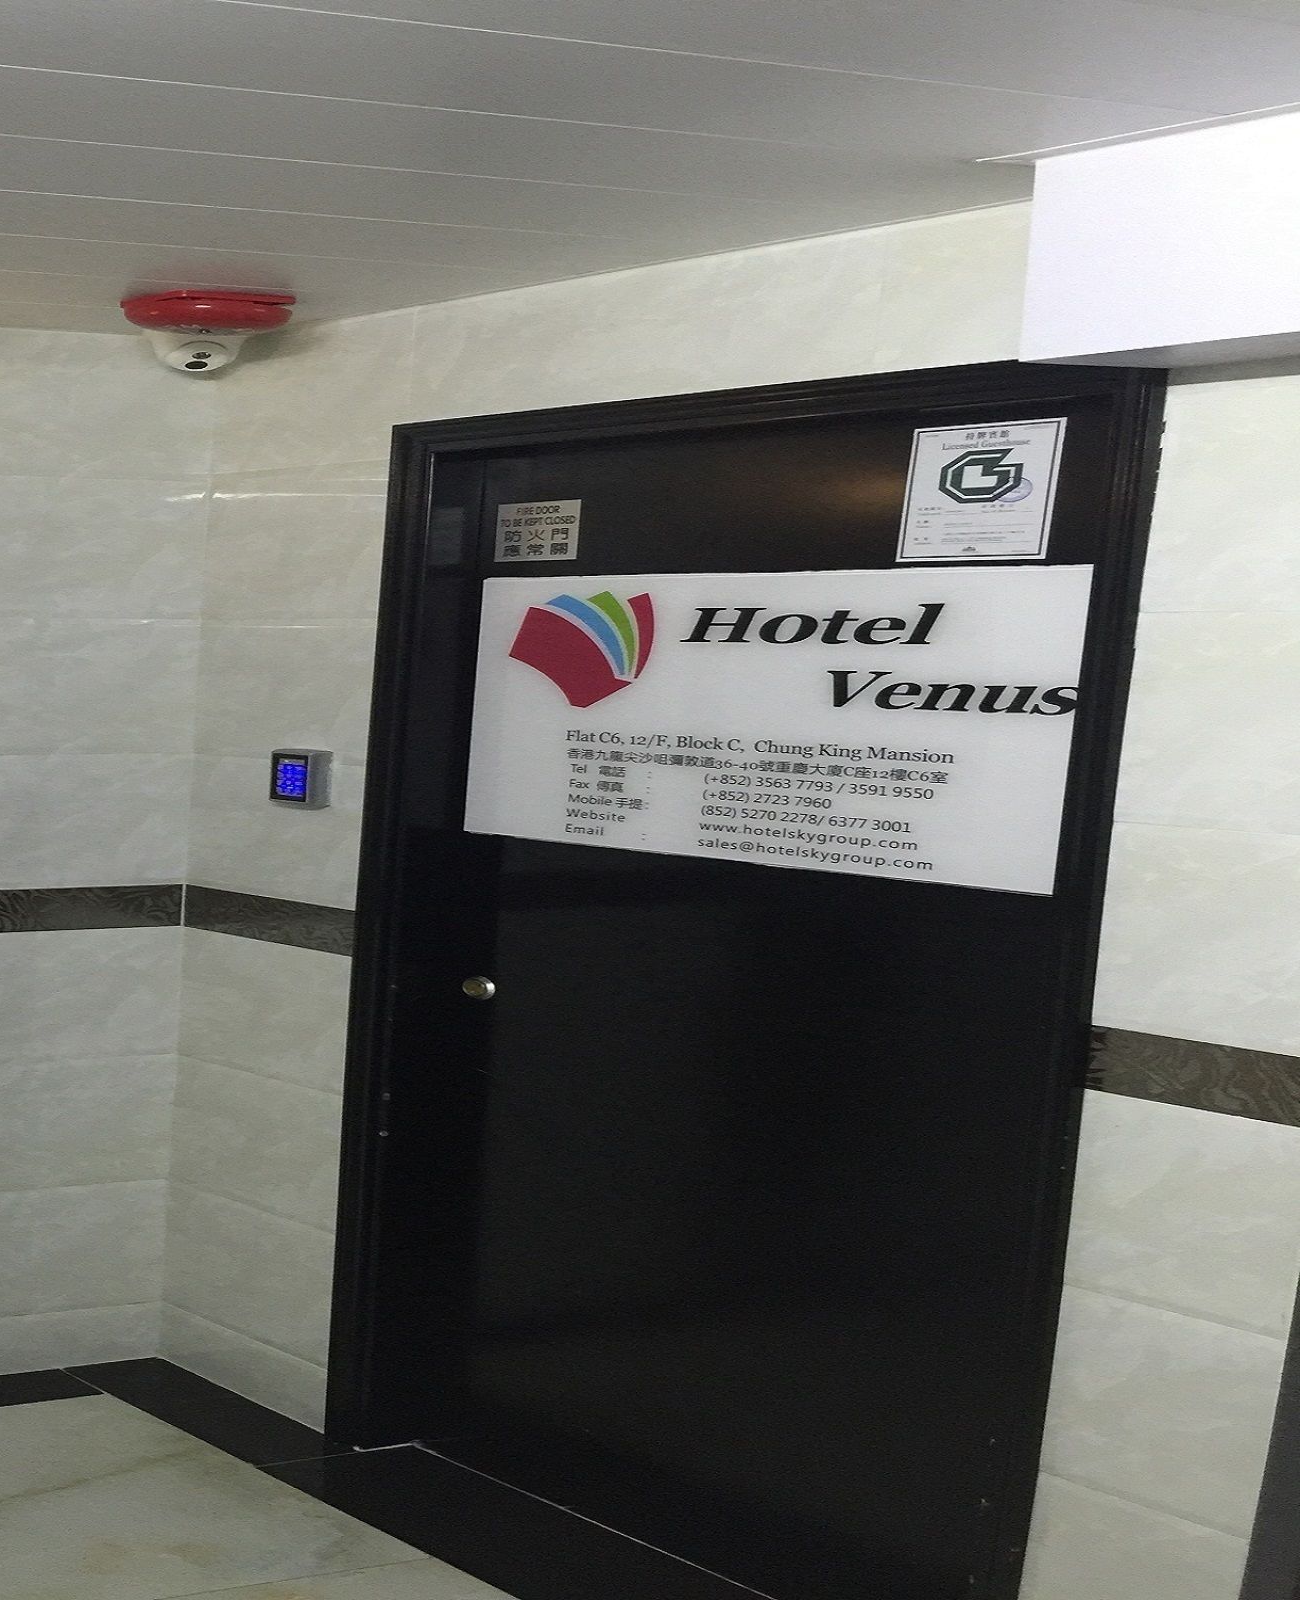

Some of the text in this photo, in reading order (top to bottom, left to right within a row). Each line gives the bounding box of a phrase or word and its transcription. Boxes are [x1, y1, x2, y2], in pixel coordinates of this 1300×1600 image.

[941, 438, 1031, 451] Licensed Guesthouse
[516, 505, 560, 516] FIRE DOOR
[501, 515, 576, 528] TO BE KEPT CLOSED
[504, 527, 569, 543] 防火門
[680, 602, 946, 646] Hotel
[826, 669, 1080, 716] Venus
[565, 729, 955, 764] Flat C6, 12/F, Block C, Chung King Mansion
[570, 763, 587, 774] Tel
[598, 765, 626, 778] 電話
[569, 779, 590, 789] Fax
[704, 773, 752, 788] (+852)
[755, 776, 792, 789] 3563
[797, 779, 834, 793] 7793
[848, 783, 888, 797] 3591
[892, 786, 934, 800] 9550
[567, 793, 612, 807] Mobile
[702, 789, 832, 809] (+852) 2723 7960
[566, 808, 626, 823] Website
[700, 805, 737, 819] (852)
[740, 808, 777, 821] 5270
[828, 816, 867, 829] 6377
[871, 819, 911, 833] 3001
[565, 823, 604, 836] Email
[699, 822, 918, 851] www.hotelskygroup.com
[697, 837, 934, 870] sales@hotelskygroup.com
